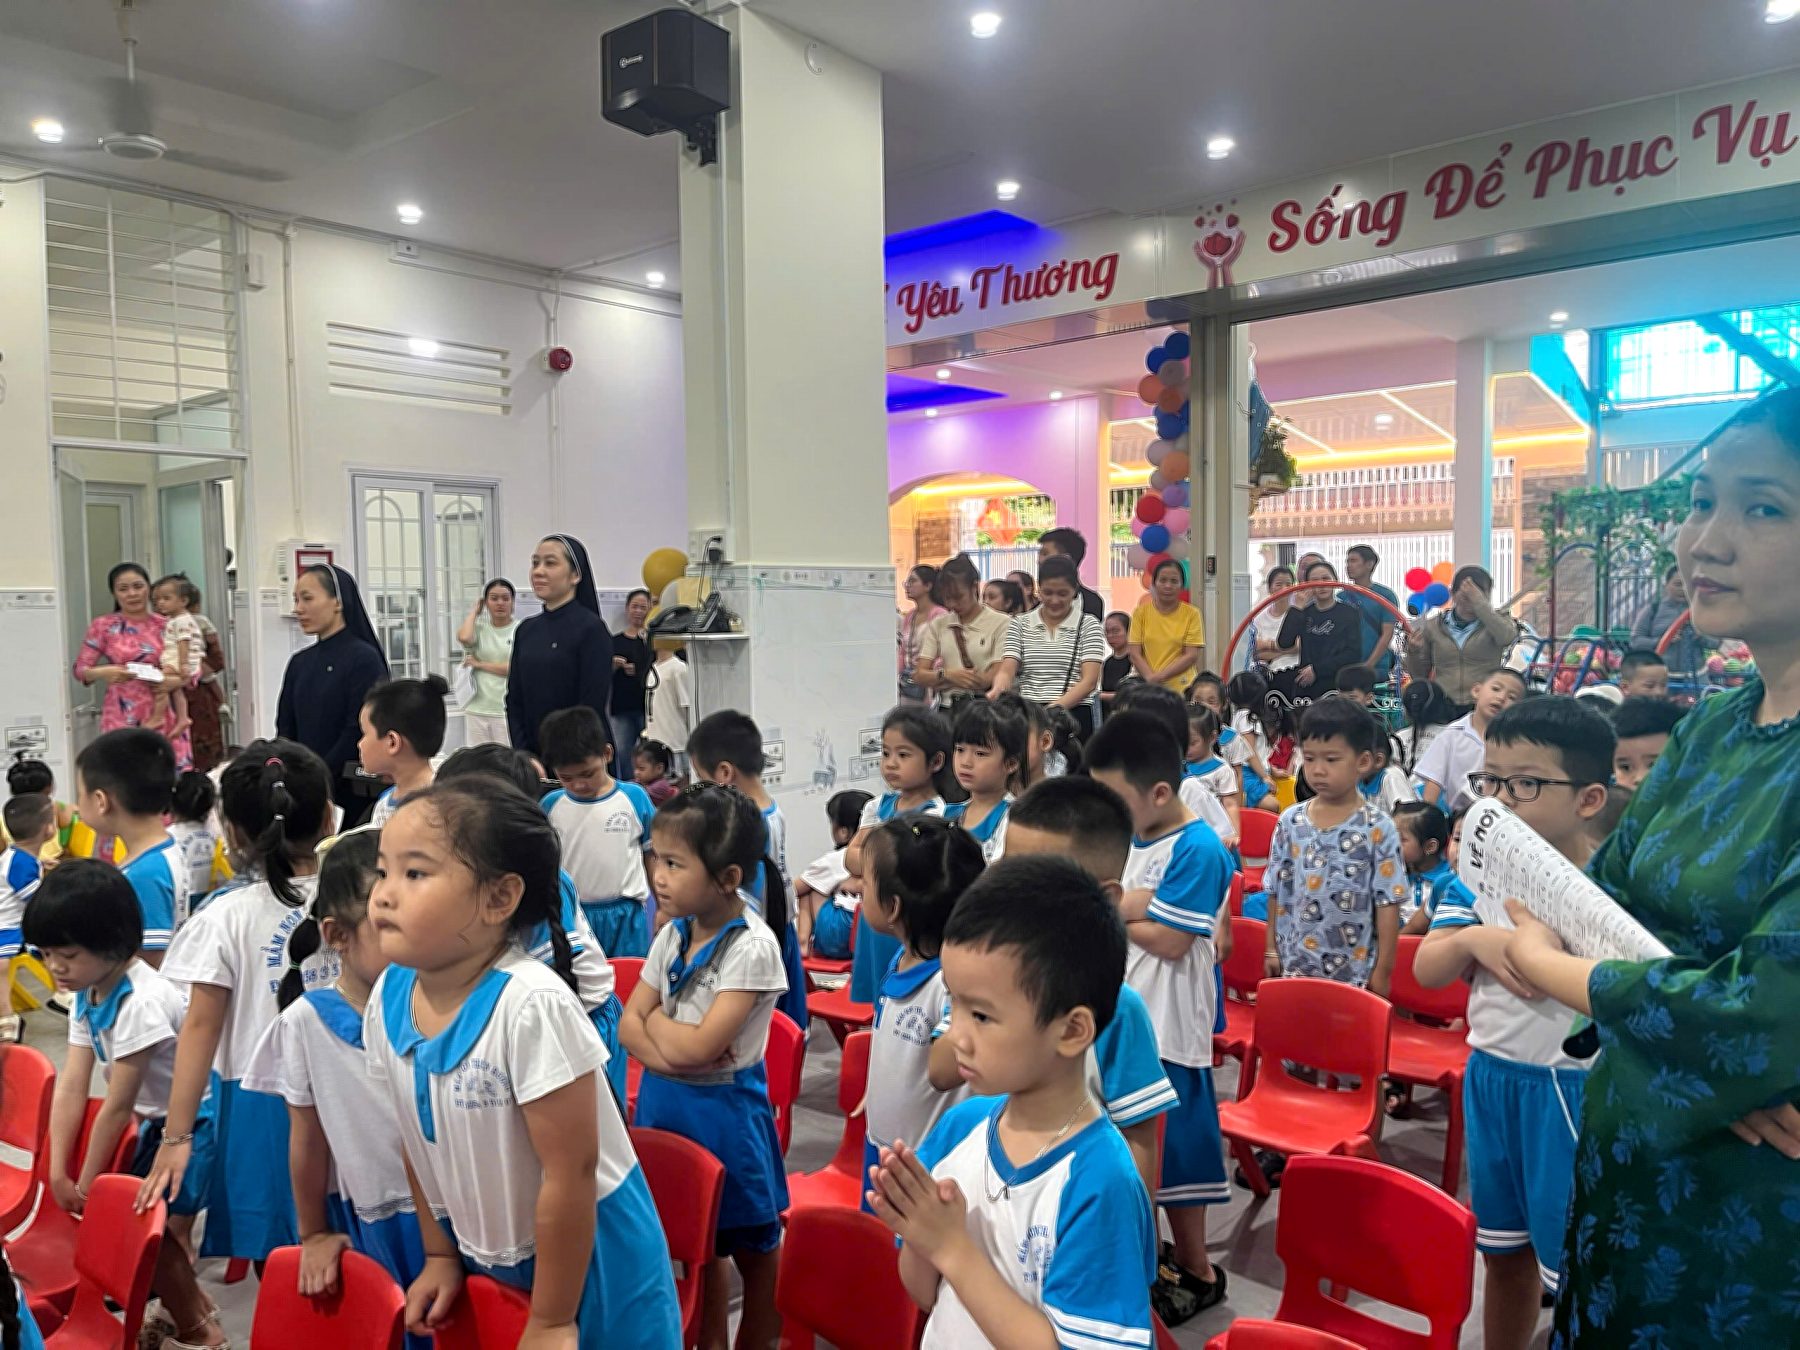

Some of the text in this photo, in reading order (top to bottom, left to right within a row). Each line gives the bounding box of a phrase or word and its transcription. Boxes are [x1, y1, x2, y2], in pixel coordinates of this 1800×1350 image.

[1267, 99, 1799, 254] Sống Để Phục Vụ
[896, 252, 1120, 334] Yêu Thương
